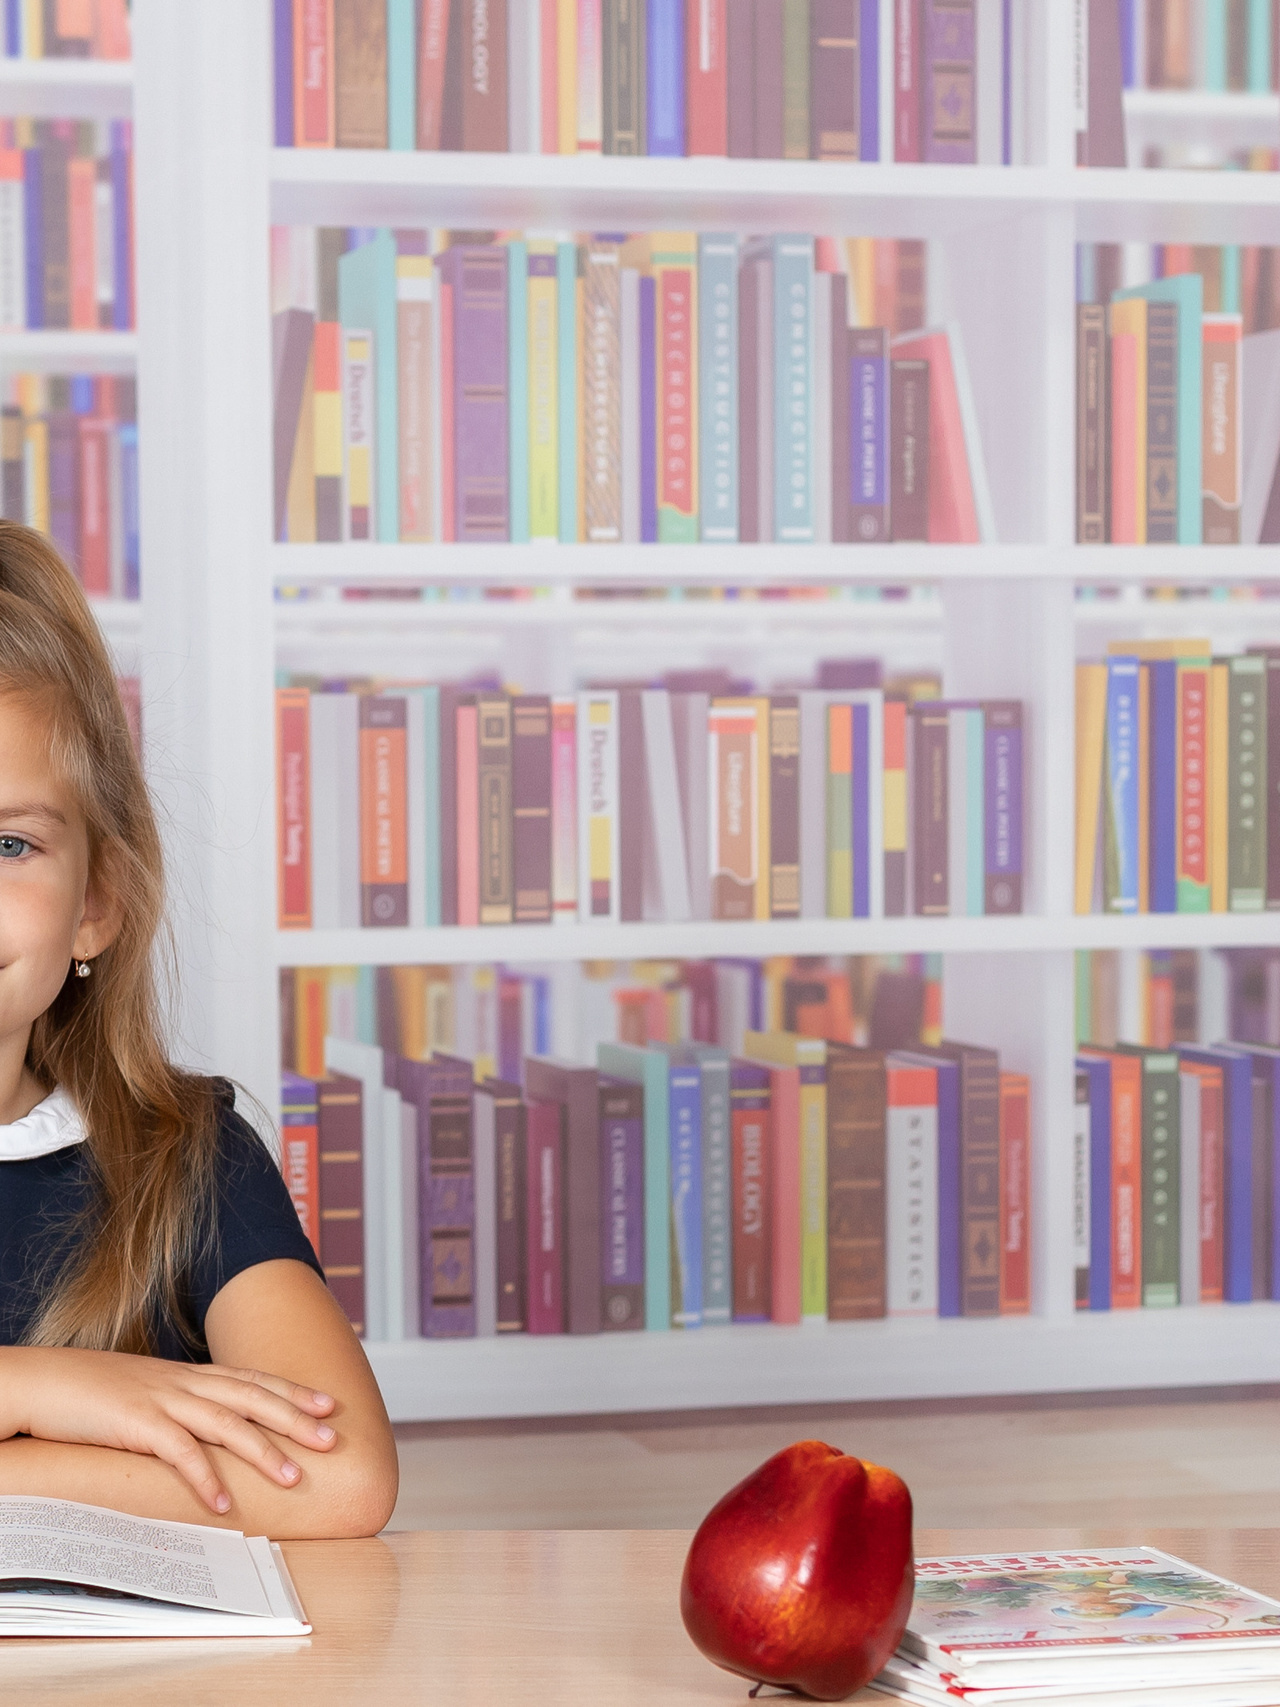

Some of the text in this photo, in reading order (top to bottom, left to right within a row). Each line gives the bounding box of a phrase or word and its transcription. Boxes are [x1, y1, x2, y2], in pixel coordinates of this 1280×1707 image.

[351, 365, 368, 444] Deutsch
[667, 292, 686, 491] PSYCHOLOGY
[715, 283, 731, 509] CONSTRUCTION
[791, 283, 807, 509] CONSTRUCTION
[590, 729, 609, 812] Deutsch
[1185, 690, 1202, 865] PSYCHOLOGY
[1240, 692, 1255, 830] BIOLOGY
[709, 1093, 724, 1292] CONSTRUCTION
[742, 1124, 763, 1237] BIOLOGY
[907, 1116, 924, 1303] STATISTICS
[1153, 1088, 1169, 1225] BIOLOGY
[915, 1555, 1102, 1569] ЧТЕНИ
[915, 1559, 1158, 1577] ВНЕКЛАСС
